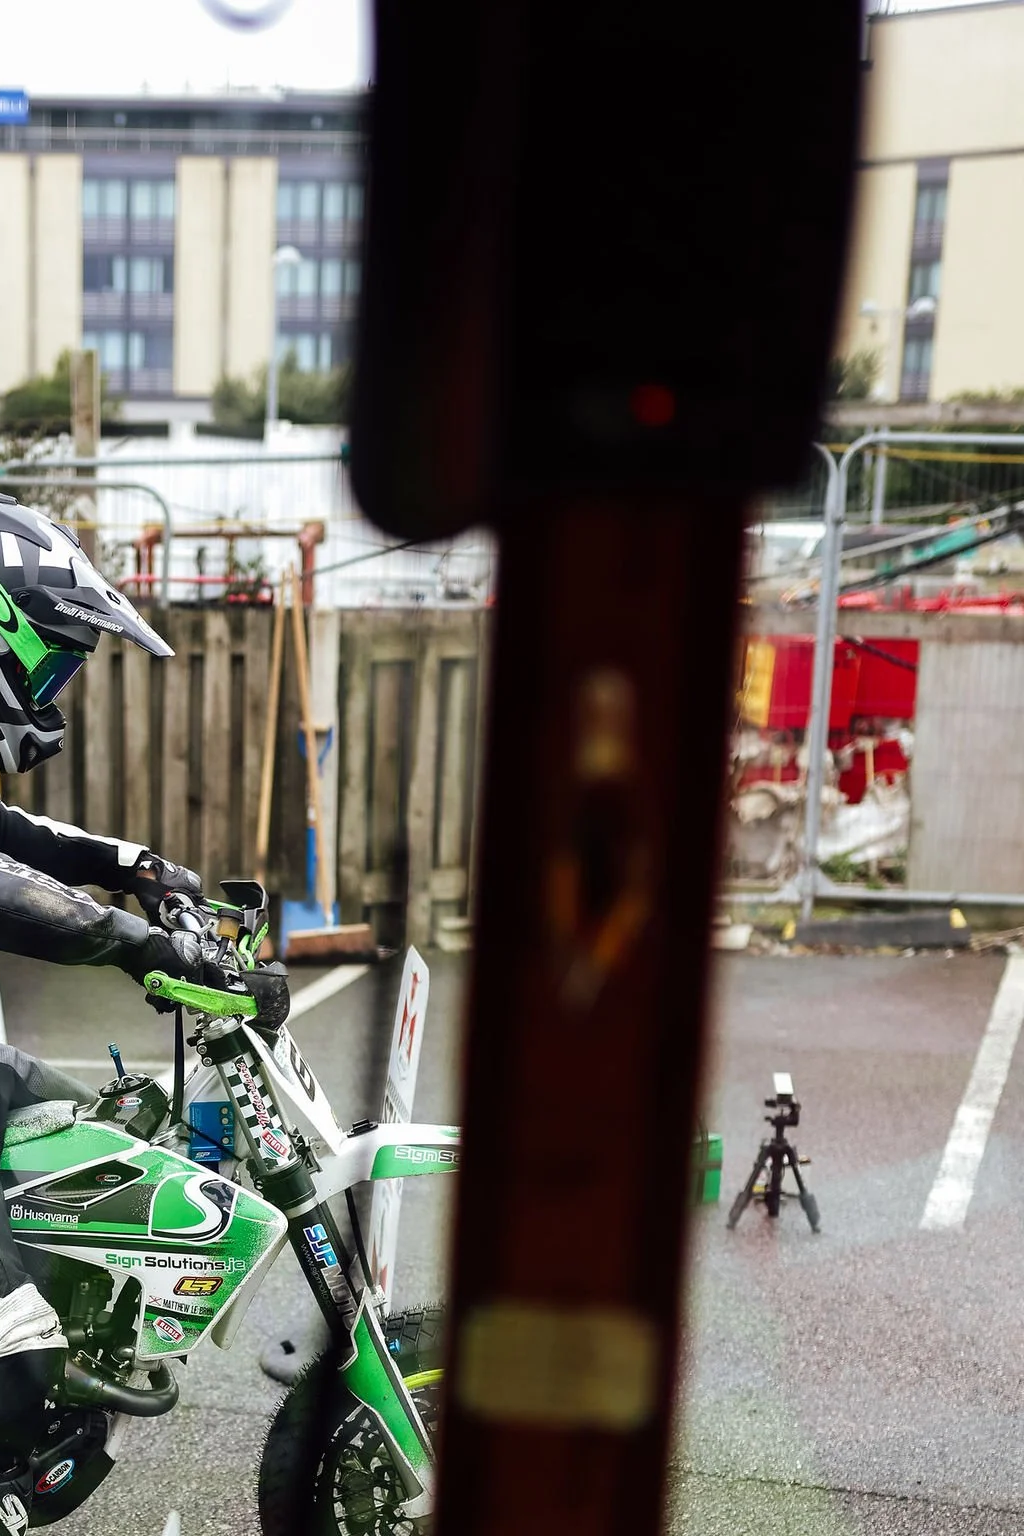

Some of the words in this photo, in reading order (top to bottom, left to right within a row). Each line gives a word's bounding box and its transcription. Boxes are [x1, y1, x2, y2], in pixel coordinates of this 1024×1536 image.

[264, 1132, 288, 1156] RUBIS
[24, 1208, 80, 1223] Husqvarna
[104, 1253, 142, 1268] Sign
[144, 1256, 246, 1272] Solutions.je
[163, 1299, 190, 1312] MATTHEW
[159, 1321, 180, 1340] RUBIS
